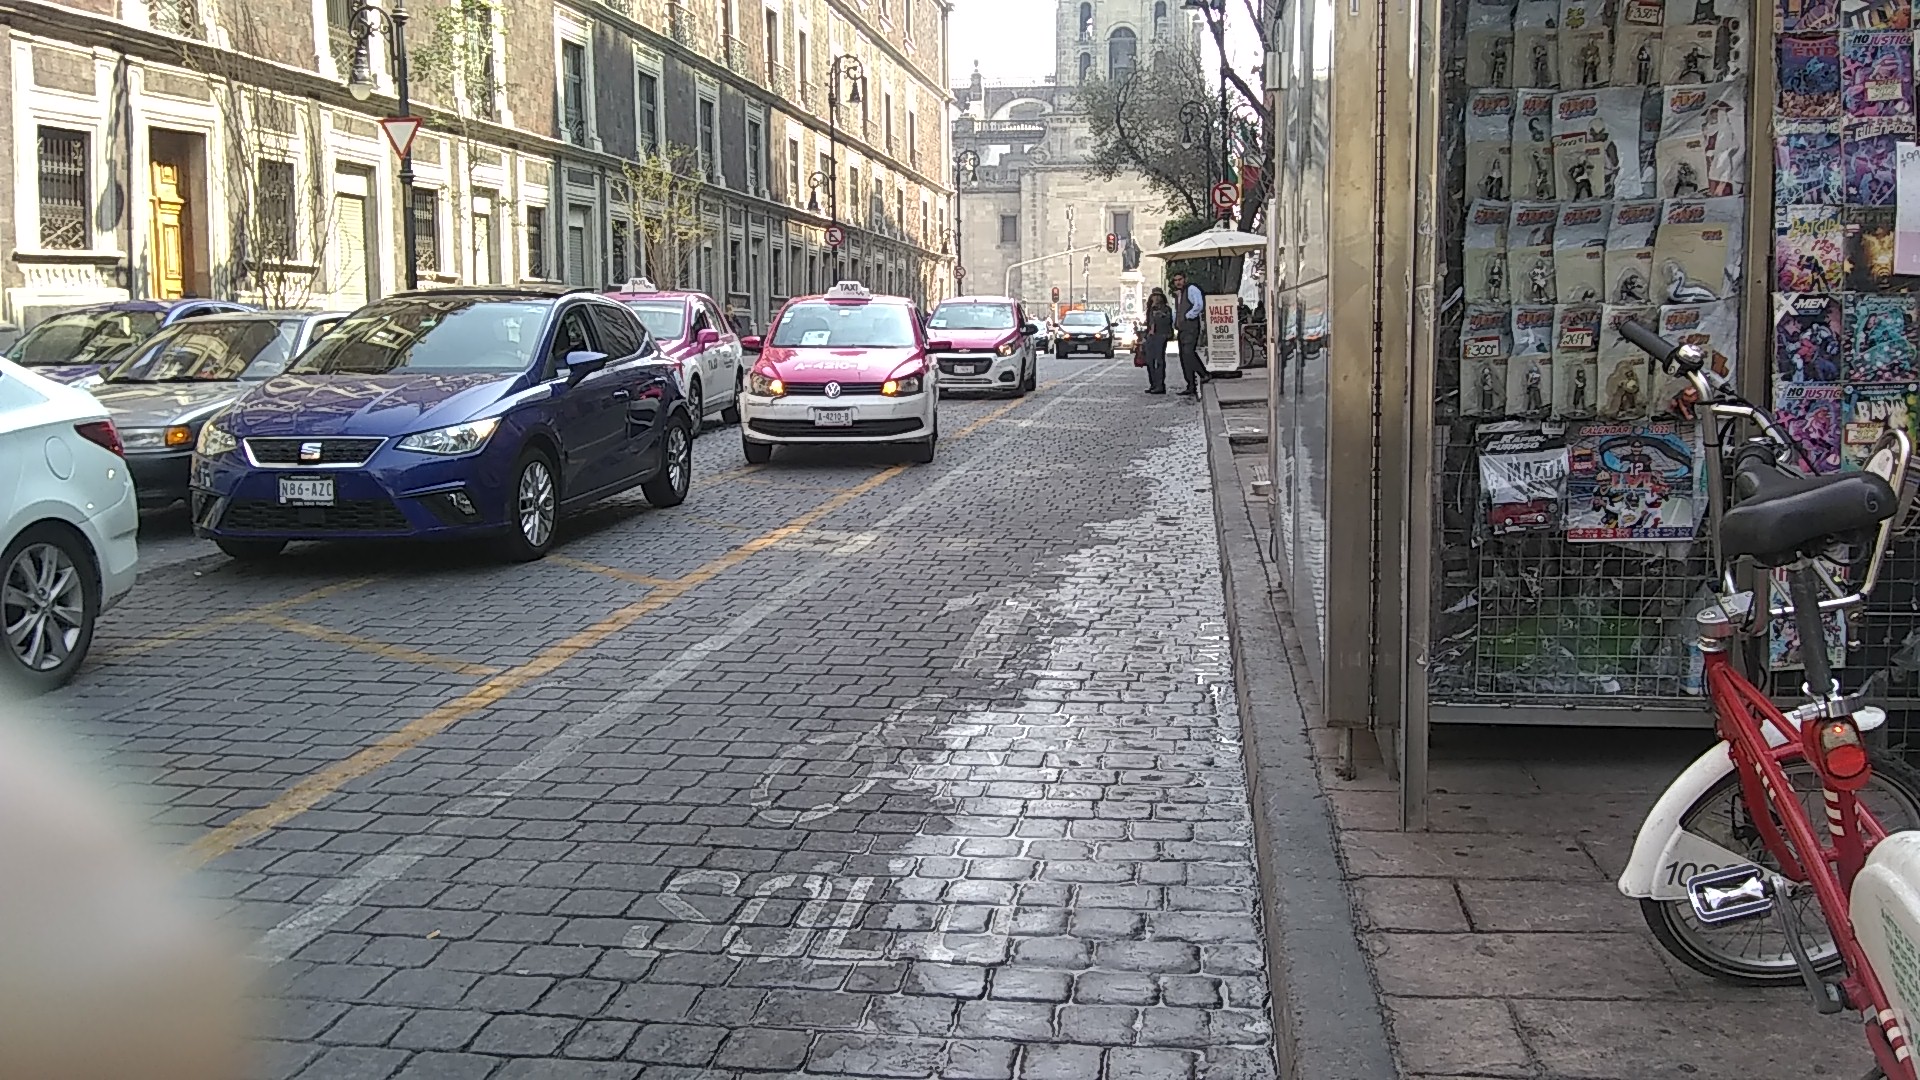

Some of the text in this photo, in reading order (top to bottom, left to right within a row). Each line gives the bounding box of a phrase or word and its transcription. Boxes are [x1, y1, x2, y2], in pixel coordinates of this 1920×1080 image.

[1854, 34, 1913, 45] NO JUSTICE
[1209, 305, 1233, 315] VALET
[1210, 316, 1233, 324] PARKING
[1215, 325, 1229, 333] $60
[1787, 387, 1804, 397] NO
[282, 483, 332, 496] N86-AZC
